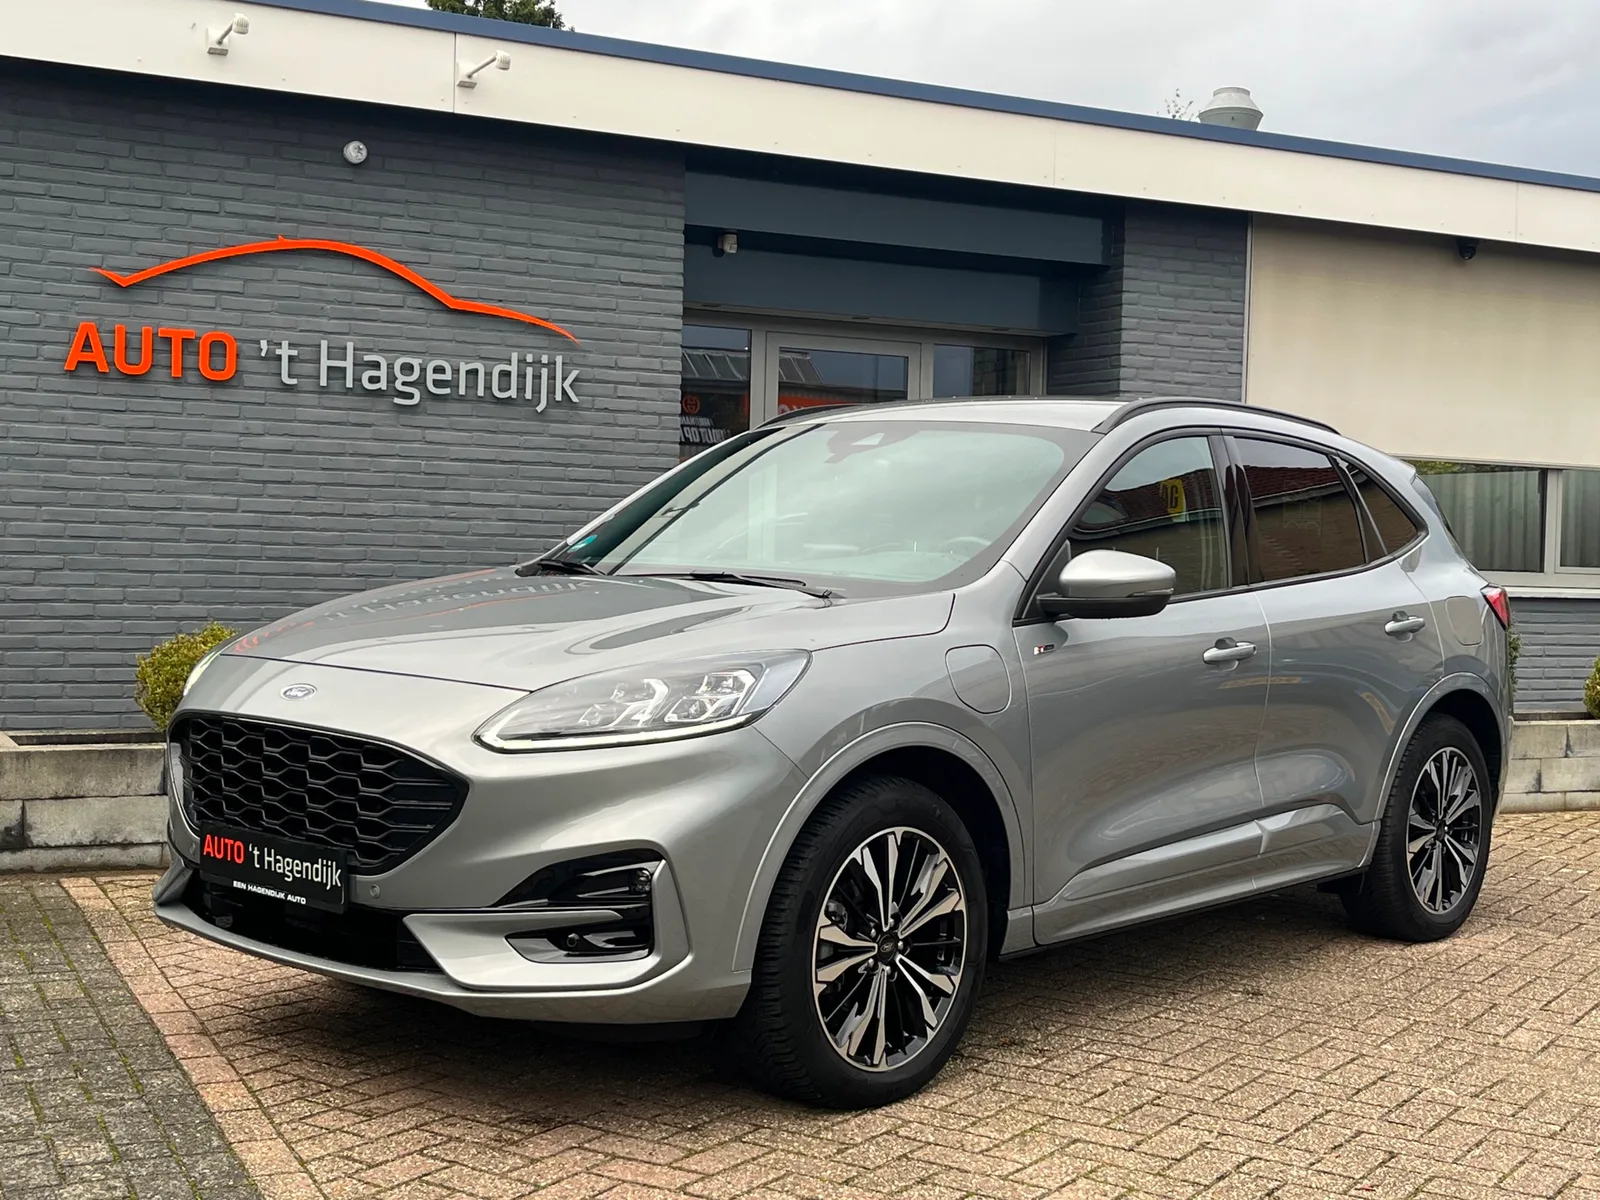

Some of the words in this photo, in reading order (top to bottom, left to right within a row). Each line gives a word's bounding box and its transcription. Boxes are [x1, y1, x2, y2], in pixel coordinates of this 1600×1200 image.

[64, 322, 238, 381] AUTO
[260, 339, 298, 385] 't
[319, 339, 581, 413] Hagendijk
[203, 834, 245, 864] AUTO
[248, 843, 260, 868] 't
[264, 847, 342, 890] Hagendijk
[232, 880, 247, 890] EEN
[247, 883, 286, 900] HAGENDIJK
[286, 893, 307, 905] AUTO
